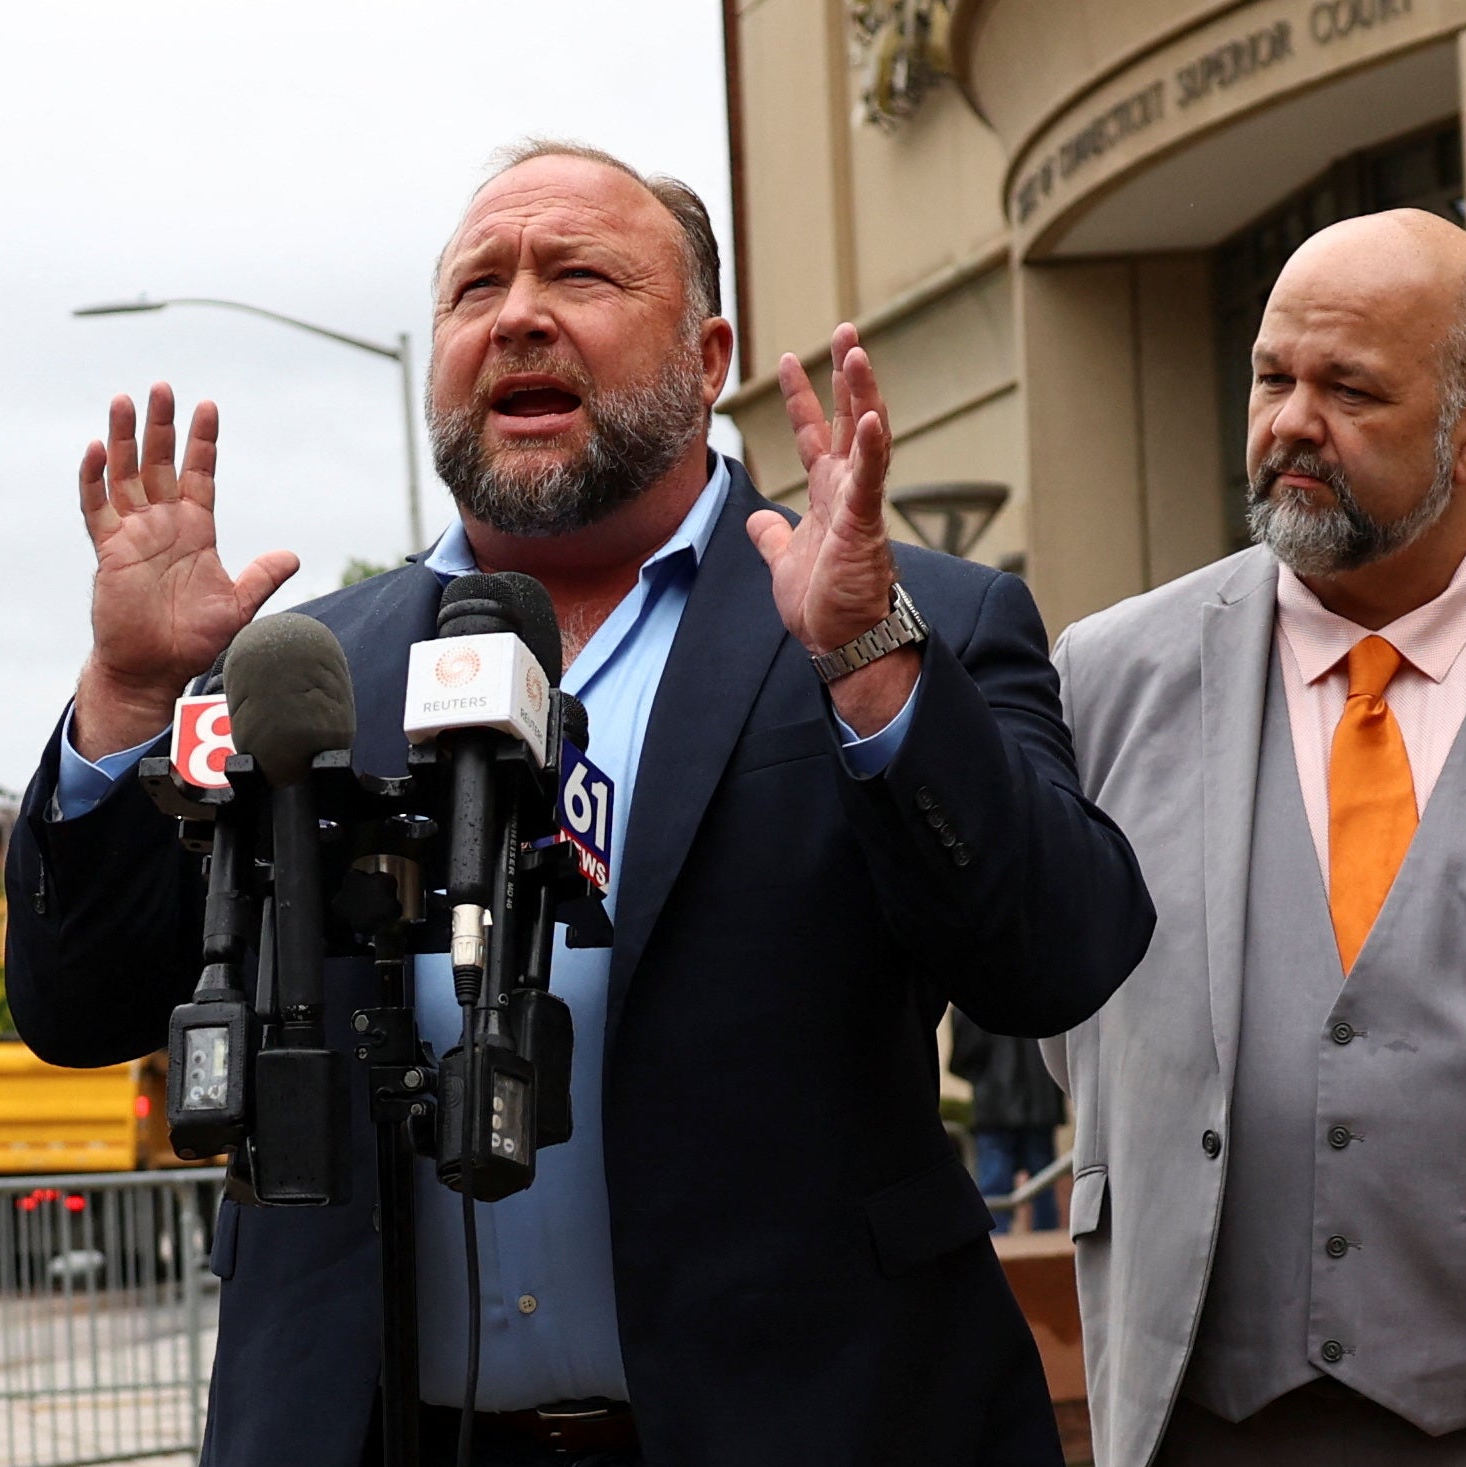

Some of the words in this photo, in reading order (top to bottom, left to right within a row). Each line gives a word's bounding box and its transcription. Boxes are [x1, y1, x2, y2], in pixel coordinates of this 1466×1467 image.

[1175, 19, 1294, 109] SUPERIOR
[1309, 0, 1412, 45] COUR
[423, 696, 487, 713] REUTERS
[188, 703, 238, 786] 8
[564, 762, 608, 852] 61
[508, 814, 517, 875] NHEISER
[560, 829, 606, 886] WS
